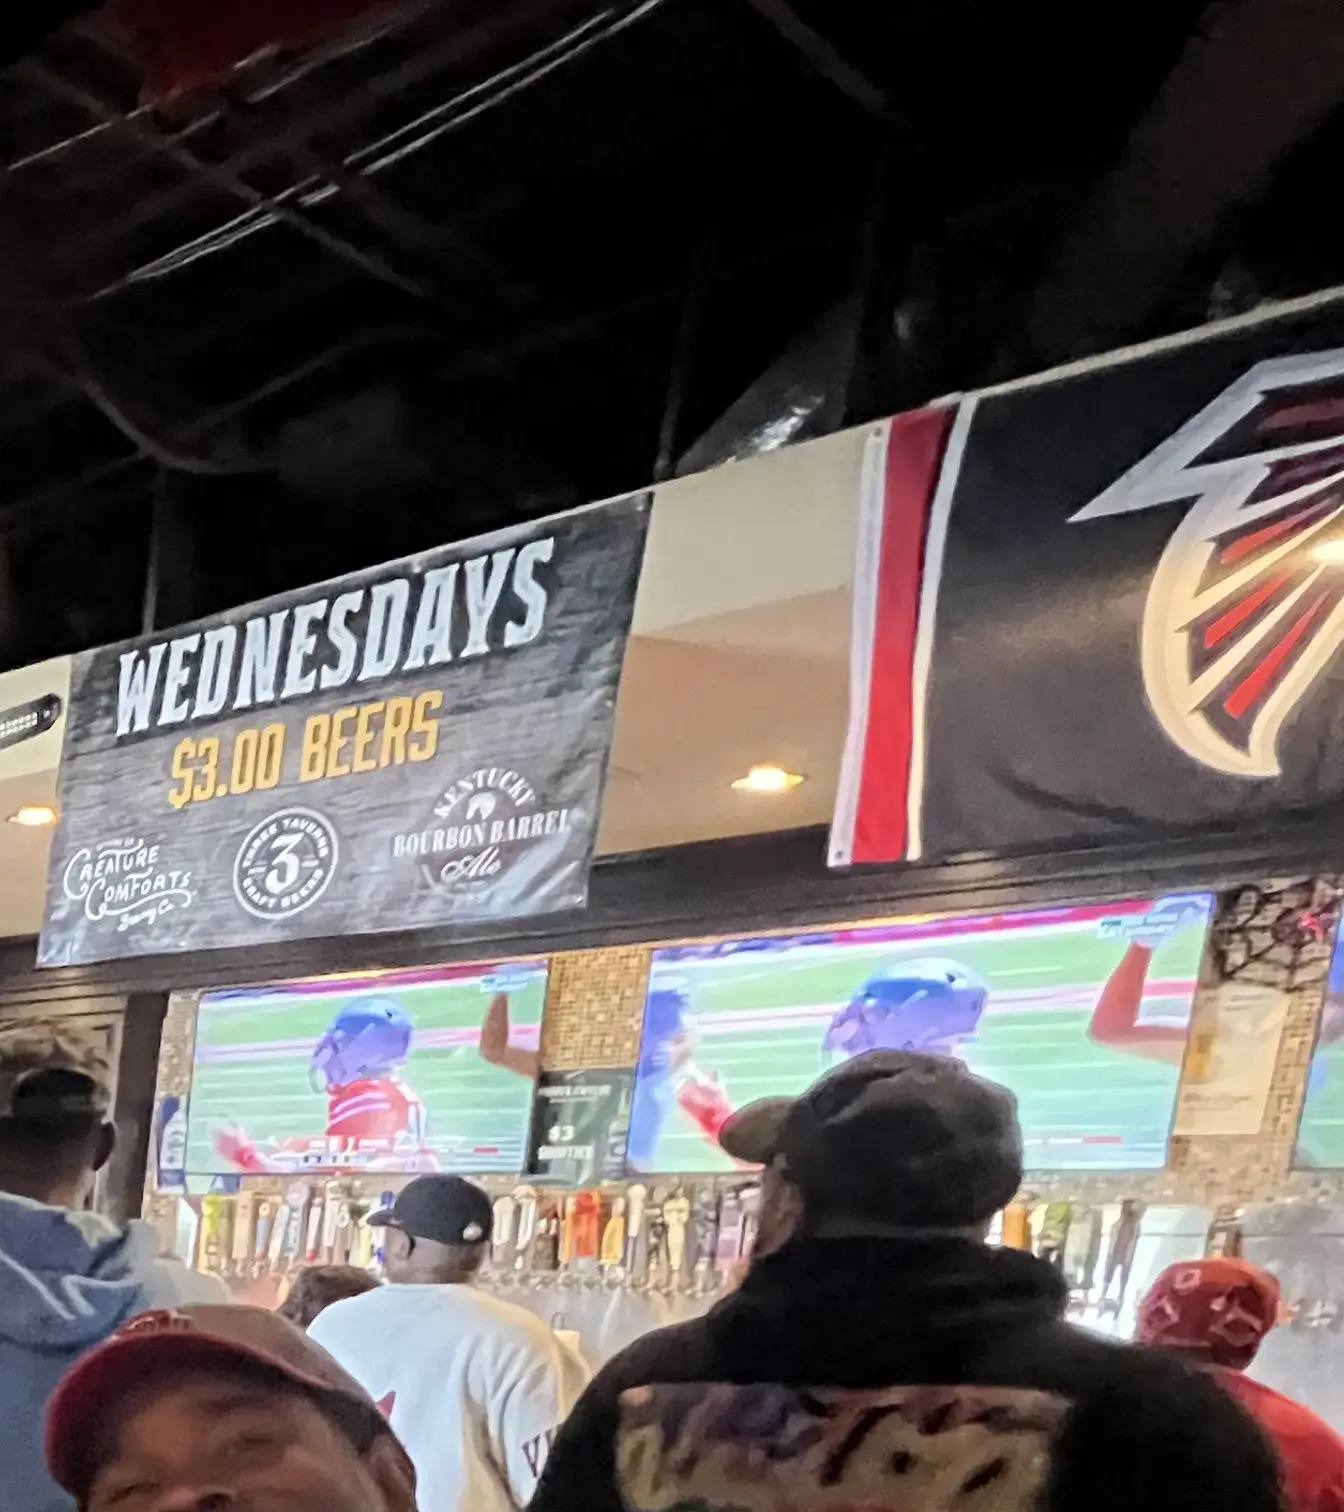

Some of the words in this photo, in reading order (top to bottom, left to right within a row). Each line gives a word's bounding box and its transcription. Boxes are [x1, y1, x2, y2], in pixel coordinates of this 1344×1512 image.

[115, 538, 555, 737] WEDNESDAYS
[169, 722, 286, 809] $3.00
[301, 689, 444, 783] BEERS
[434, 768, 536, 818] KENTUCKY
[393, 823, 487, 858] BOURBON
[489, 808, 569, 844] BARREL
[64, 844, 160, 900] CREATURE
[264, 831, 305, 895] 3
[440, 846, 502, 882] Ale
[85, 867, 192, 921] COMFORTS
